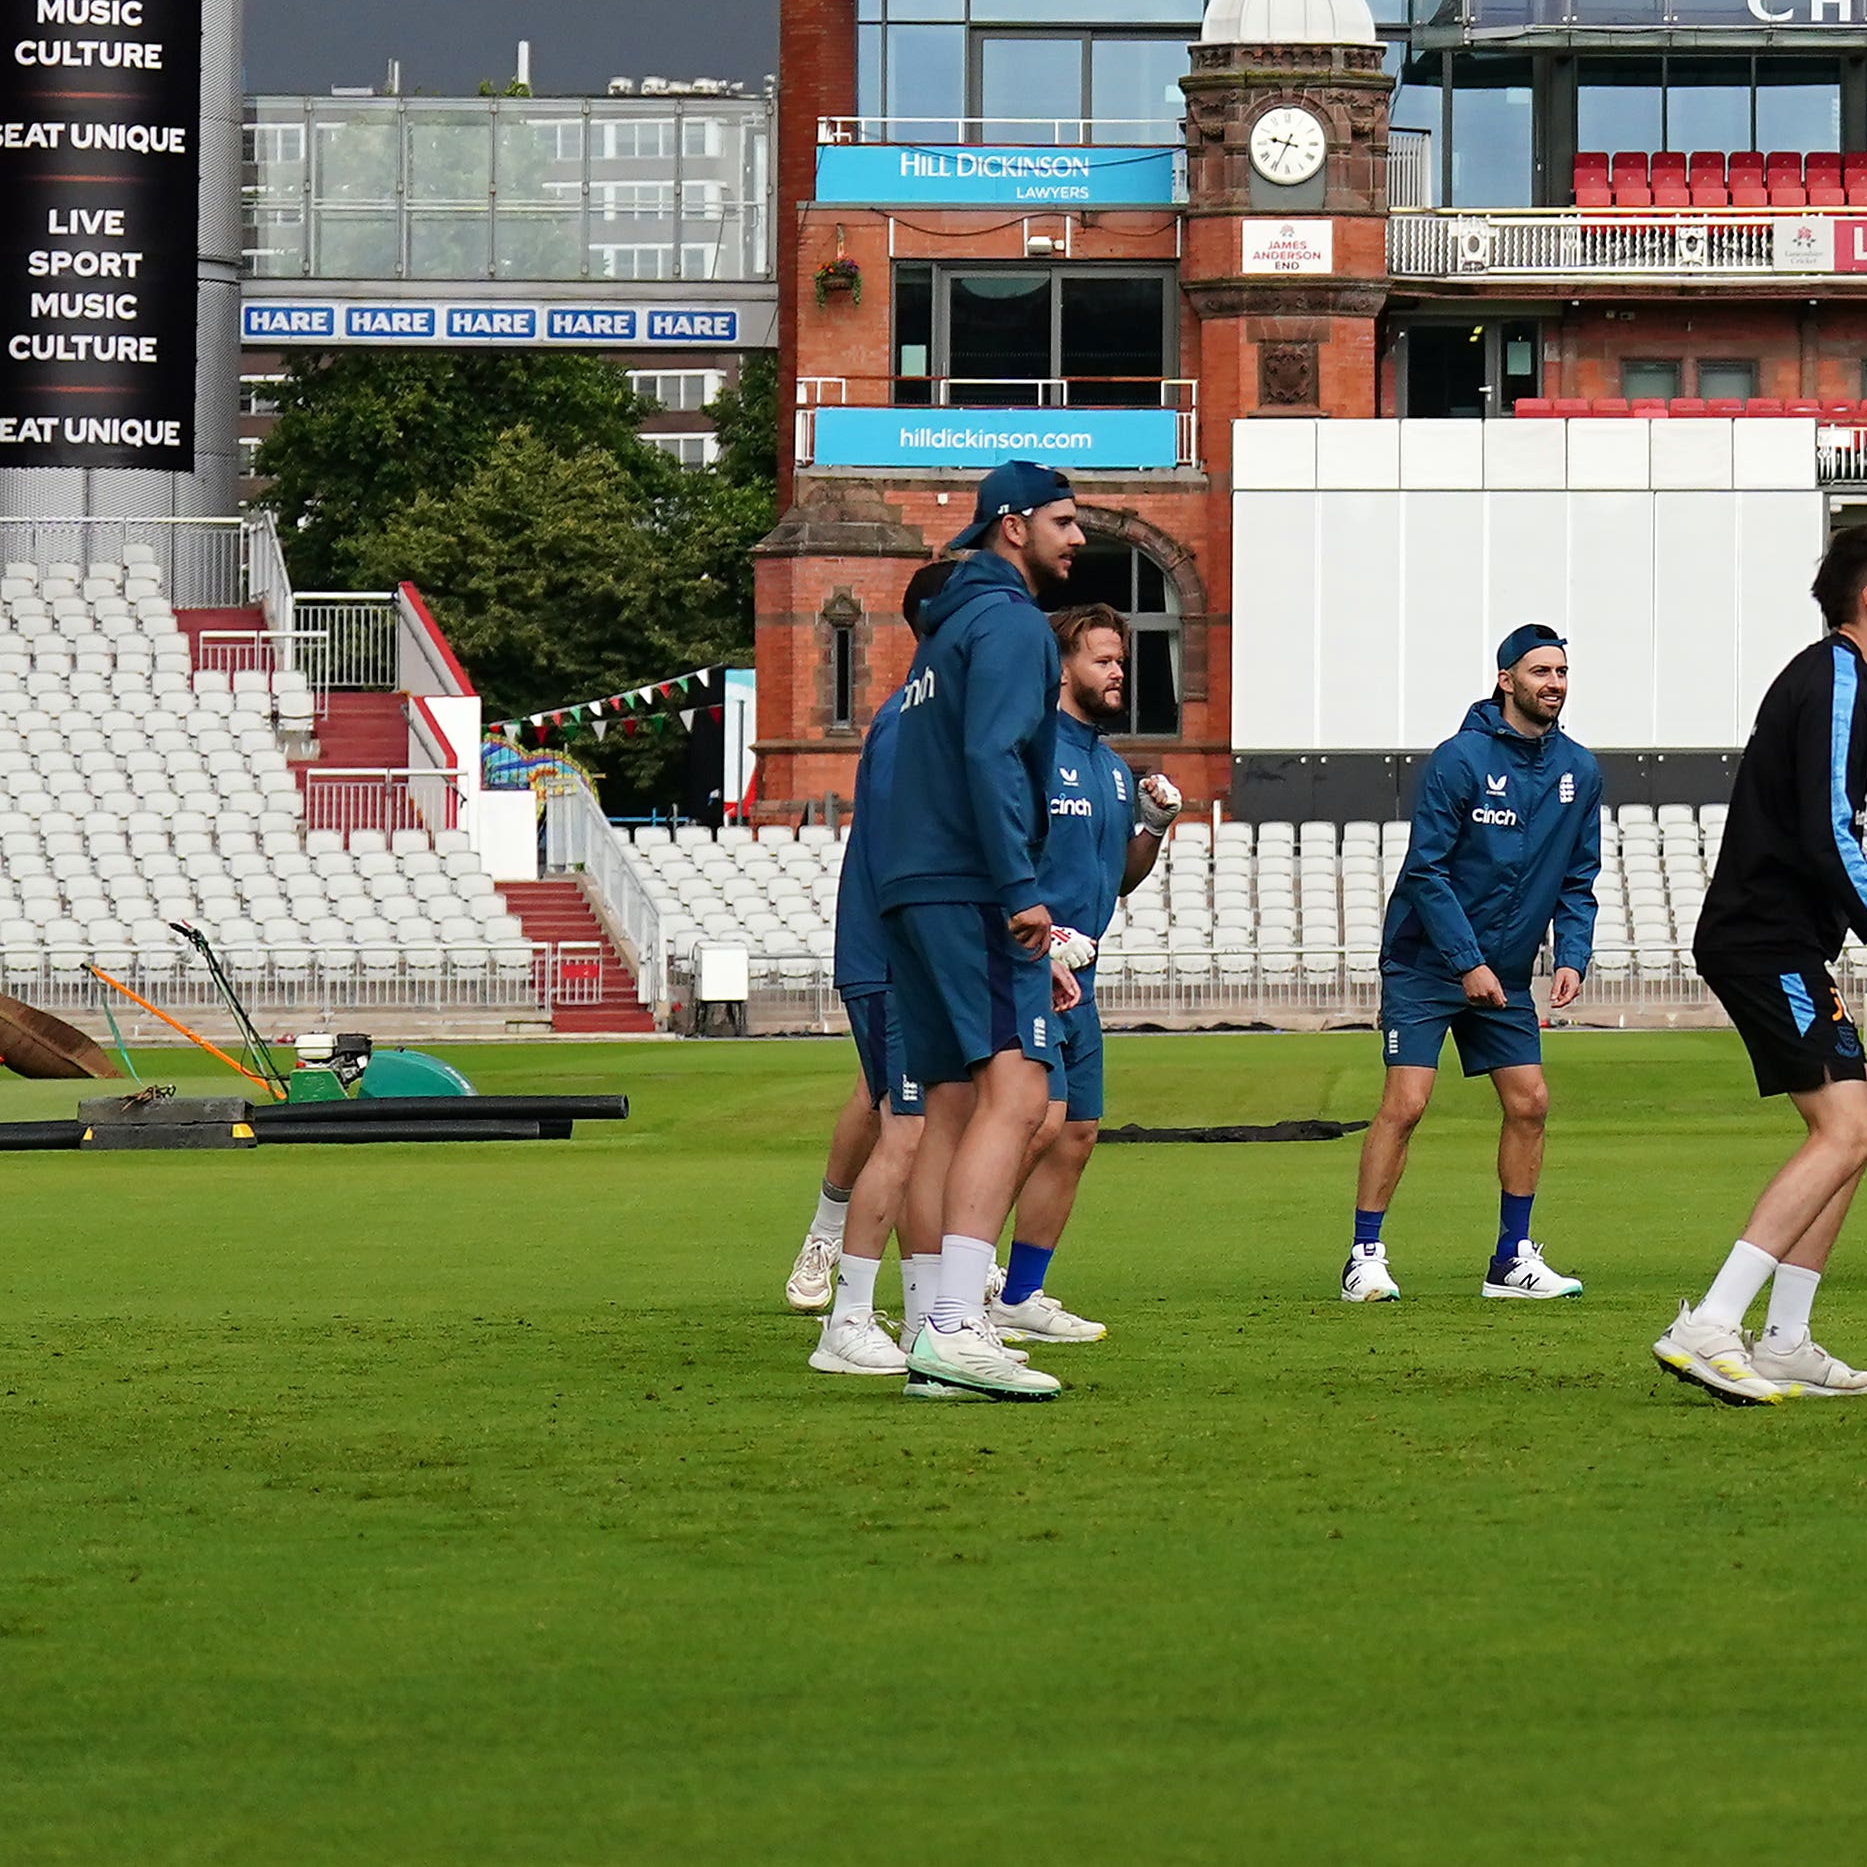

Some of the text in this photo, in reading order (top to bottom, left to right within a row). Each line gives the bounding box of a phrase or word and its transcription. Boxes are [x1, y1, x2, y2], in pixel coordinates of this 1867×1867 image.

[37, 0, 143, 26] MUSIC
[15, 40, 163, 70] CULTURE
[70, 124, 186, 154] UNIQUE
[900, 152, 1090, 178] HILL DICKINSON
[1016, 186, 1090, 200] LAWYERS
[48, 209, 125, 236] LIVE
[1253, 251, 1322, 260] ANDERSON
[1268, 241, 1307, 250] JAMES
[28, 251, 143, 278] SPORT
[1274, 261, 1300, 271] END
[31, 293, 138, 320] MUSIC
[250, 311, 328, 332] HARE
[350, 311, 430, 333] HARE
[452, 312, 531, 333] HARE
[552, 313, 631, 334] HARE
[652, 314, 731, 335] HARE
[8, 335, 158, 363] CULTURE
[64, 417, 181, 447] UNIQUE
[900, 427, 1092, 449] hilldickinson.com
[1050, 793, 1092, 817] cinch
[1471, 803, 1517, 826] cinch
